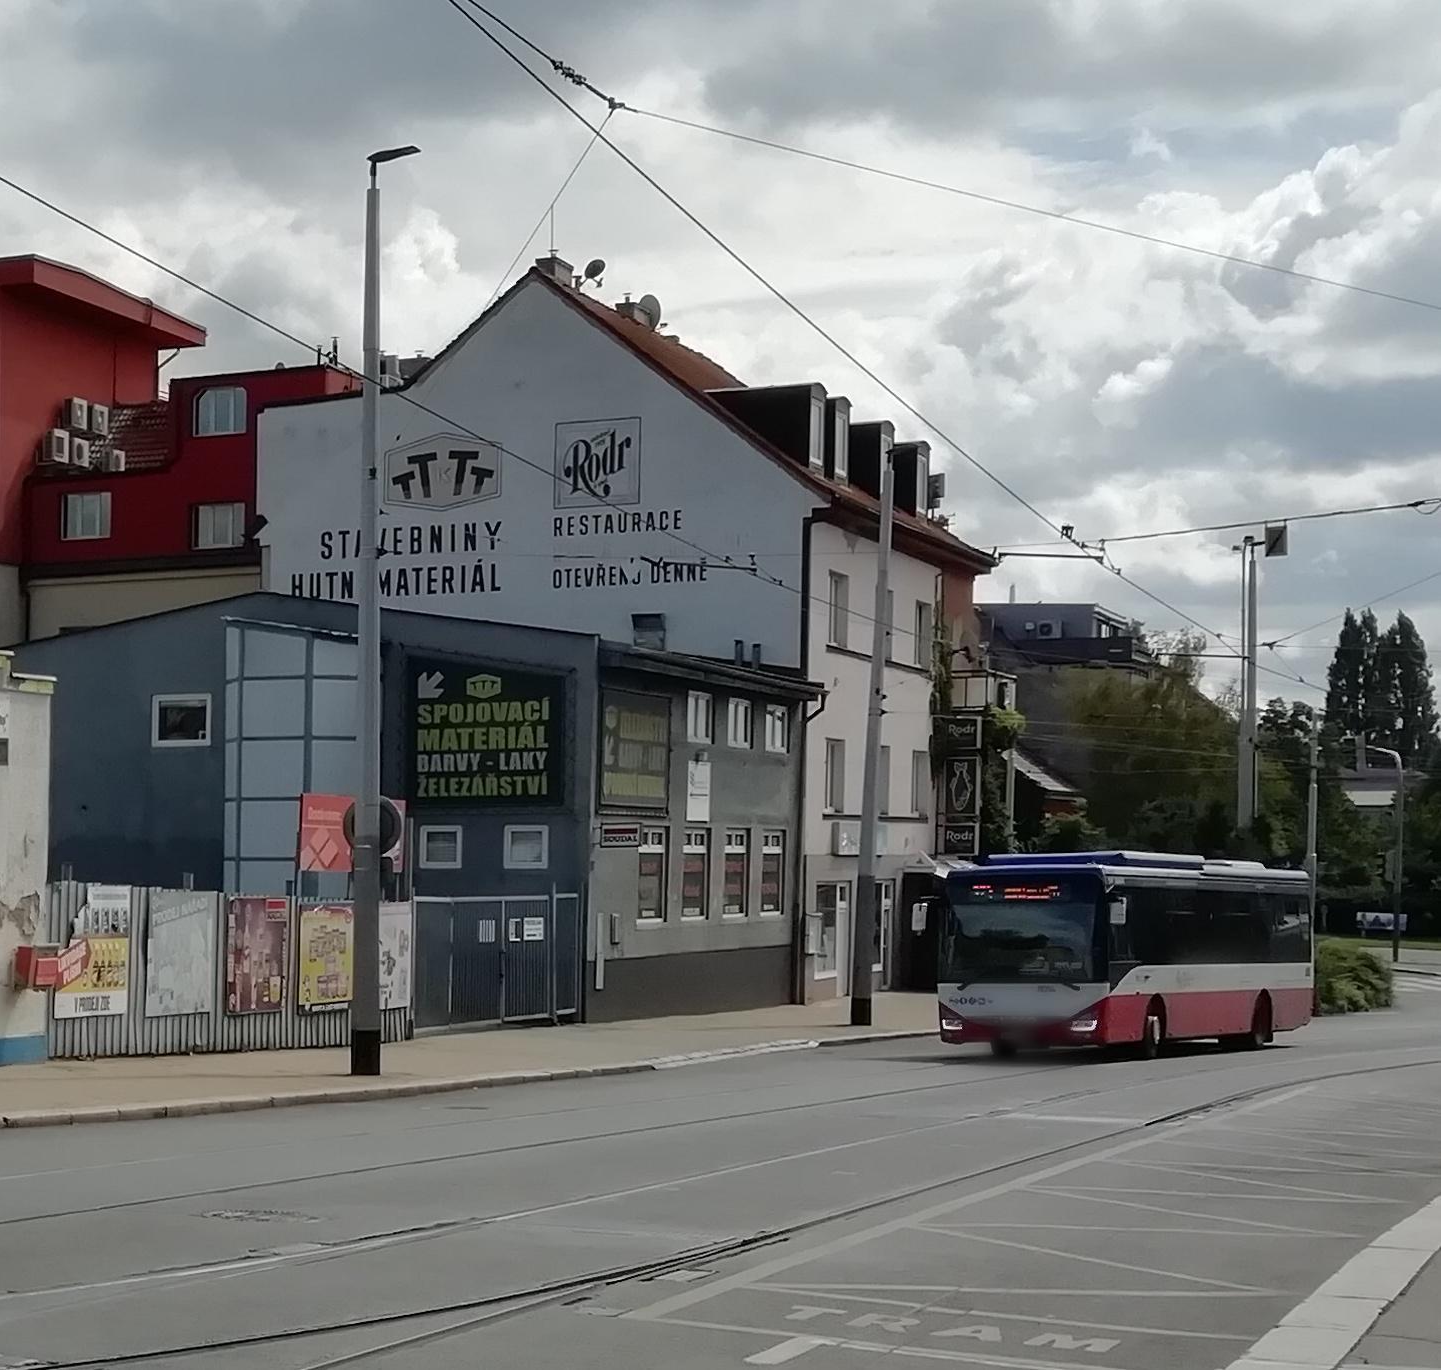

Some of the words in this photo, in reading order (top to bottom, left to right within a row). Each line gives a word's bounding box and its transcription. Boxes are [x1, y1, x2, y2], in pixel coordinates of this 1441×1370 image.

[563, 428, 631, 498] Rodr
[553, 510, 682, 537] RESTAURACE
[291, 571, 354, 599] HUTN
[379, 559, 501, 598] MATERIÁL
[417, 696, 550, 724] SPOJOVACÍ
[417, 722, 549, 751] MATERIÁL
[948, 723, 976, 737] Rodr
[417, 753, 481, 772] BARVY
[499, 751, 548, 771] LAKY
[417, 772, 548, 797] ŽELEZÁŘSTVÍ
[603, 835, 638, 843] SOUDAL
[946, 830, 974, 843] Rodr
[784, 1305, 1121, 1352] TRAM
